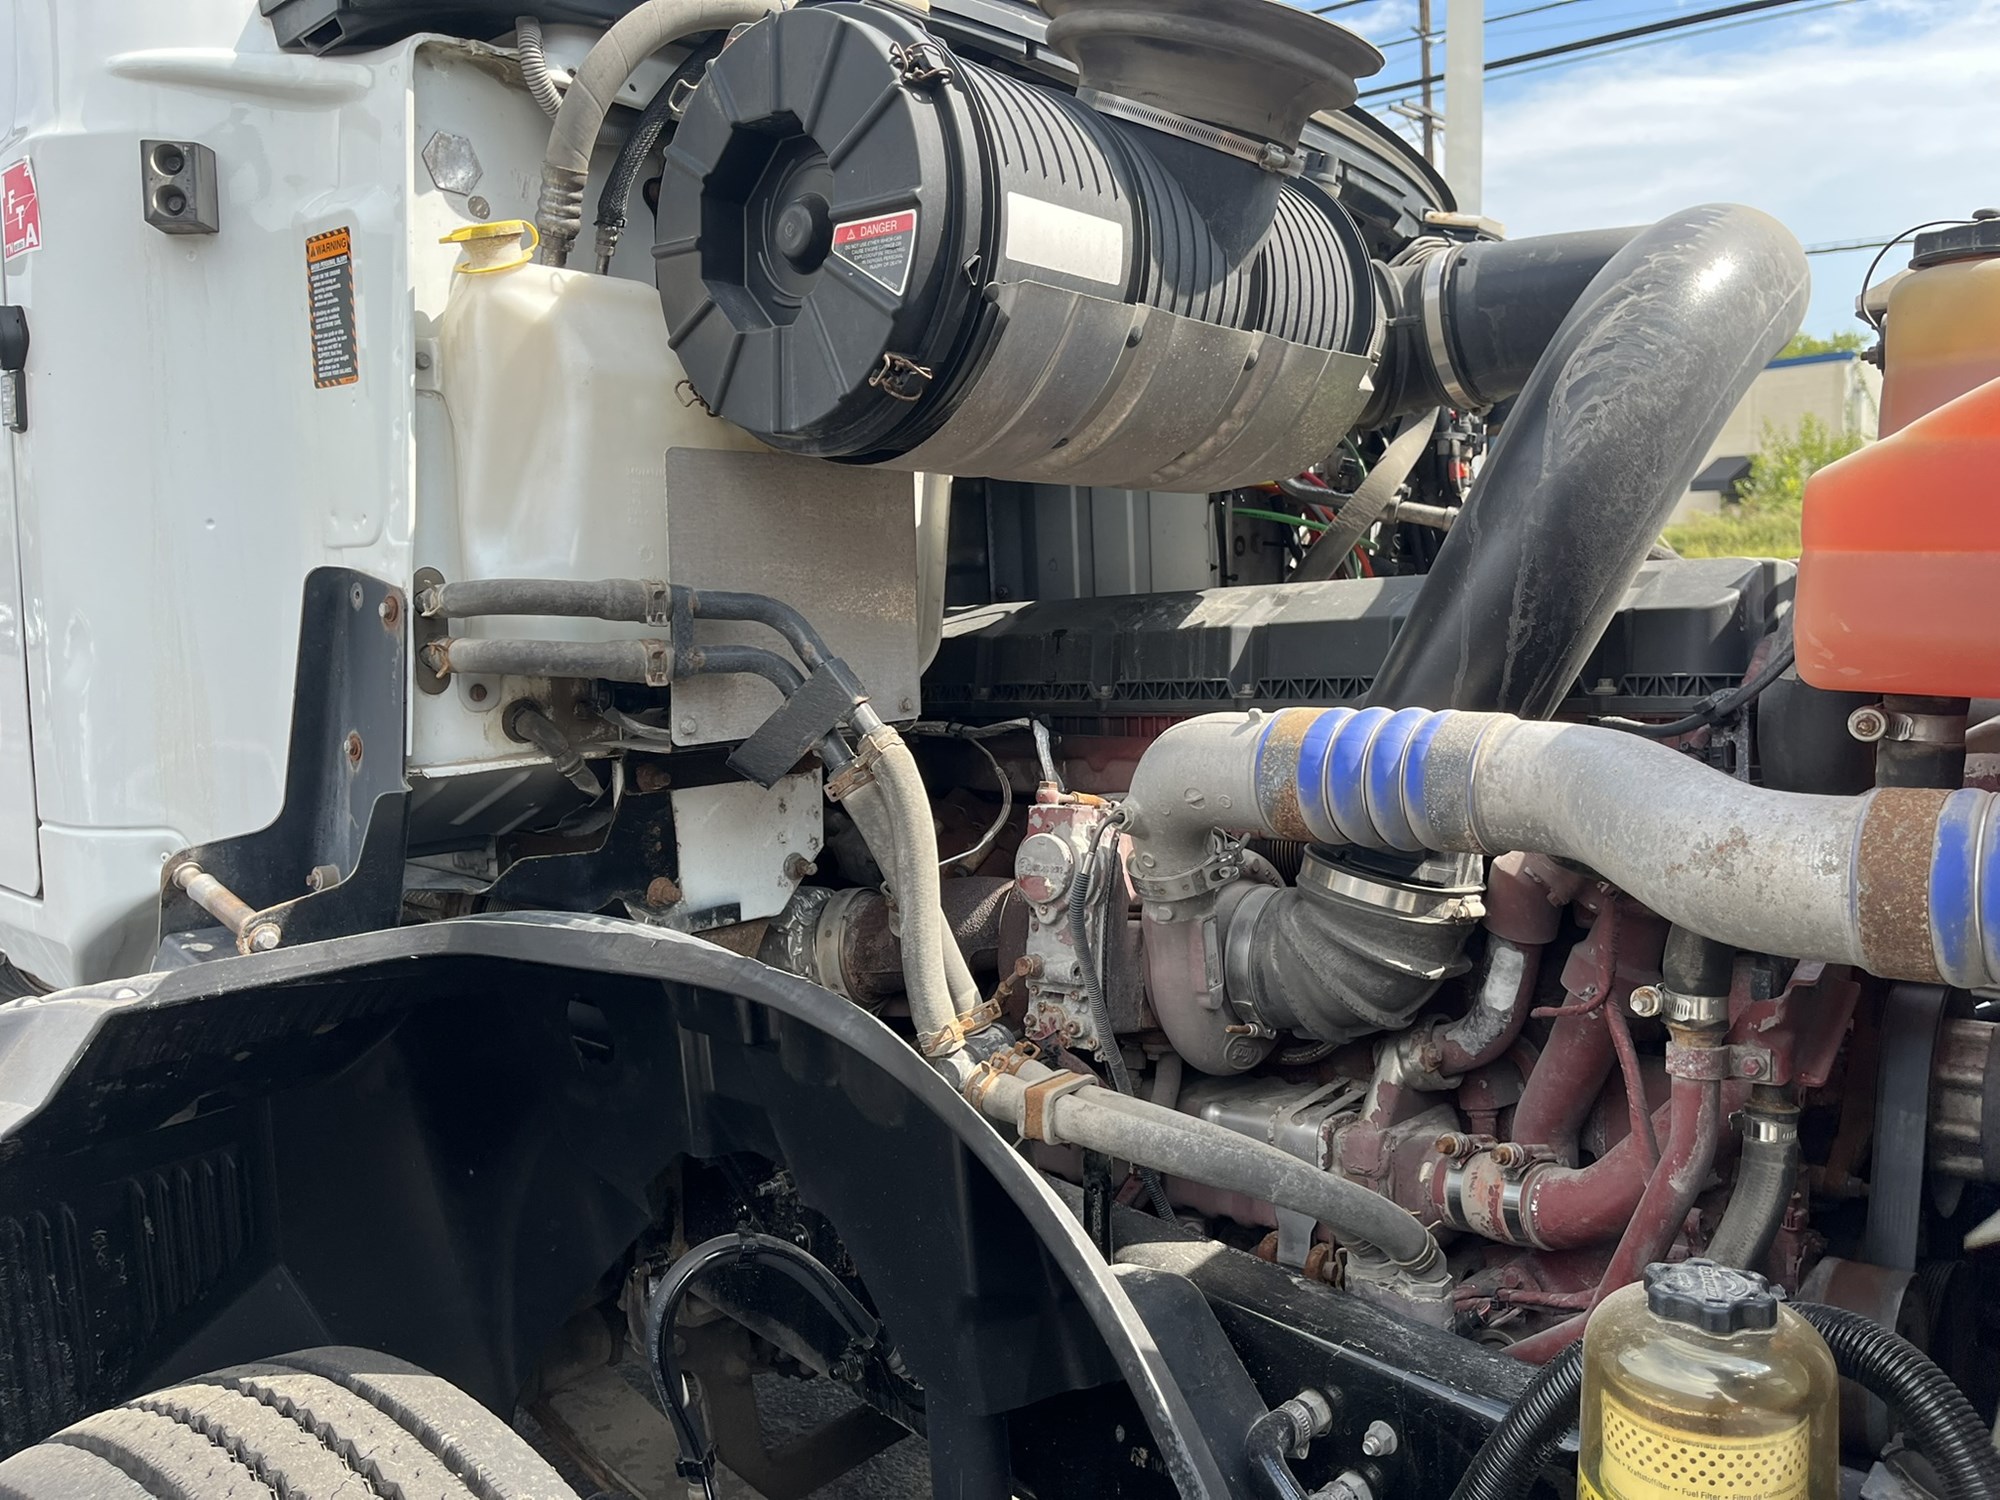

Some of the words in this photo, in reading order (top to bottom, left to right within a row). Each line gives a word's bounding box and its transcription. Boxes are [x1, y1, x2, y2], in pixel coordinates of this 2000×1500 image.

[860, 220, 898, 237] DANGER
[316, 237, 348, 256] WARNING
[1681, 1488, 1699, 1497] Fuel
[1700, 1491, 1721, 1500] Filter
